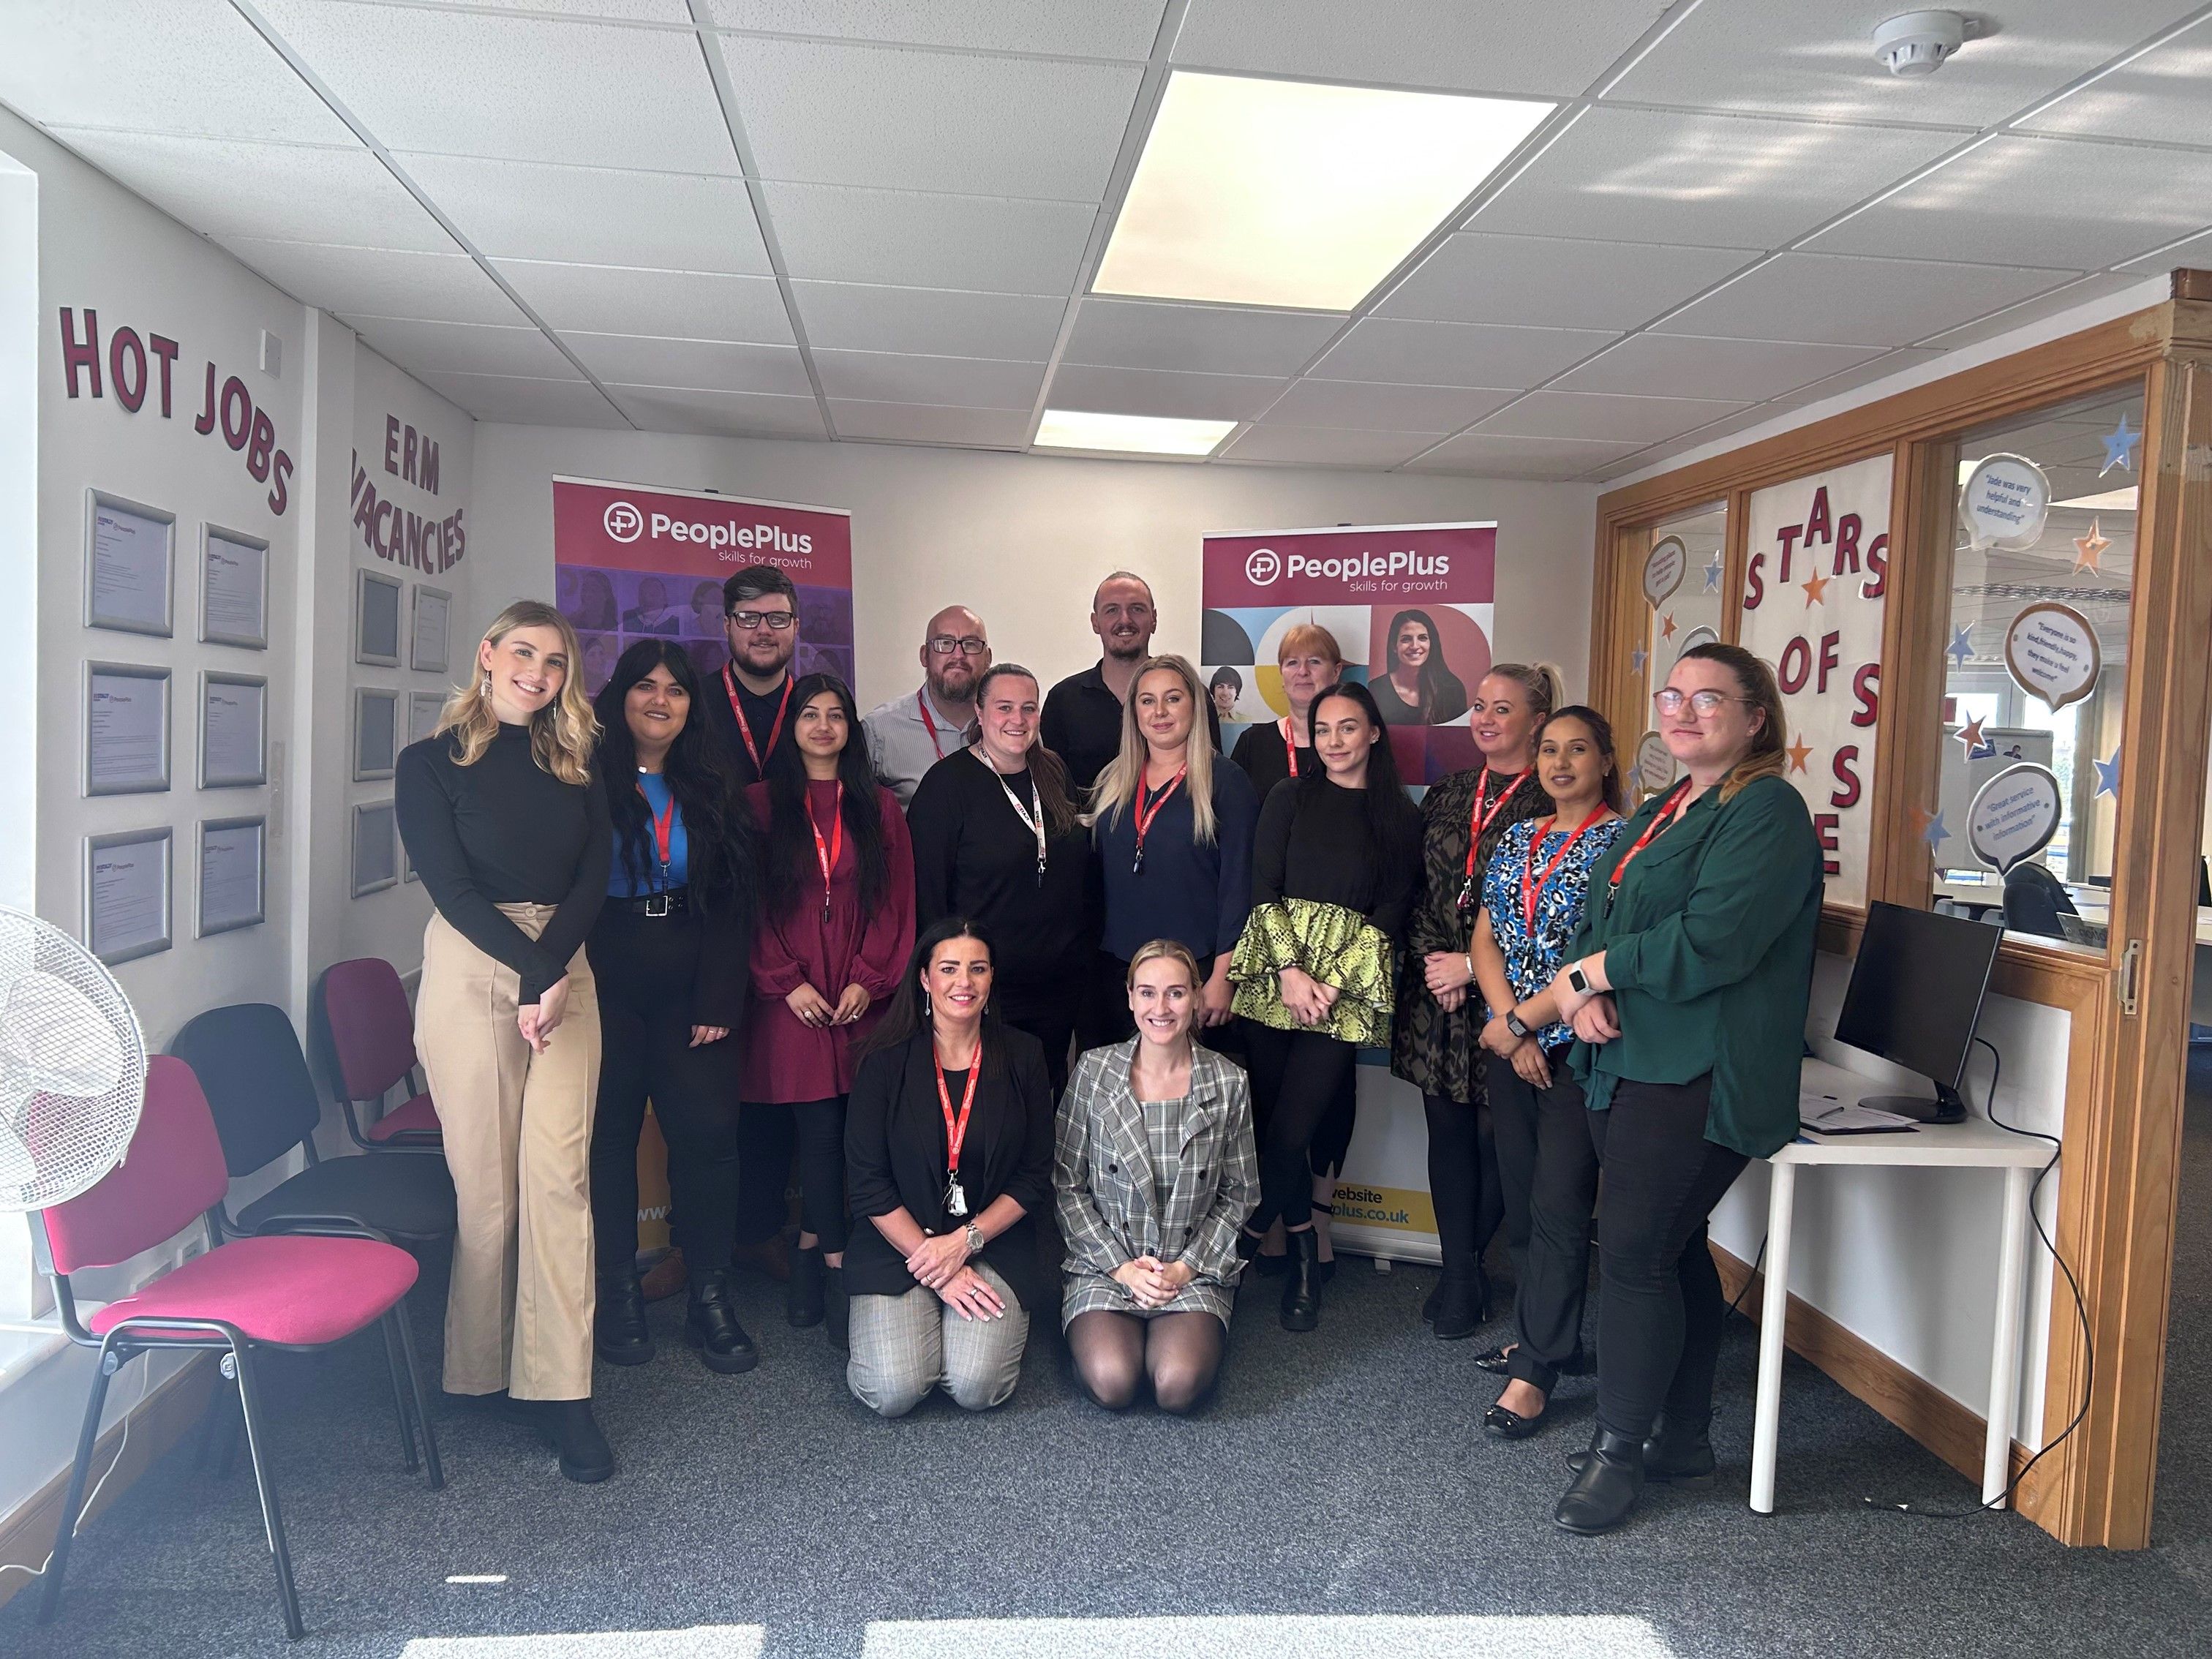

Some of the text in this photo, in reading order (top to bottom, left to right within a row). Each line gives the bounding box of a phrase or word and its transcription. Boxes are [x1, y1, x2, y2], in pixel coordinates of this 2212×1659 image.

[59, 306, 294, 516] HOT JOBS
[385, 413, 439, 496] ERM
[1985, 490, 2022, 507] helpful and
[2003, 481, 2016, 490] was
[2016, 484, 2031, 496] very
[351, 446, 465, 575] VACANCIES
[650, 513, 813, 554] PeoplePlus
[1743, 486, 1889, 610] STARS
[718, 550, 813, 570] skills for growth
[1287, 550, 1450, 582] PeoplePlus
[1350, 579, 1448, 593] skills for growth
[1778, 630, 1840, 695] OF
[2009, 787, 2034, 803] service
[1985, 800, 2041, 829] with informative
